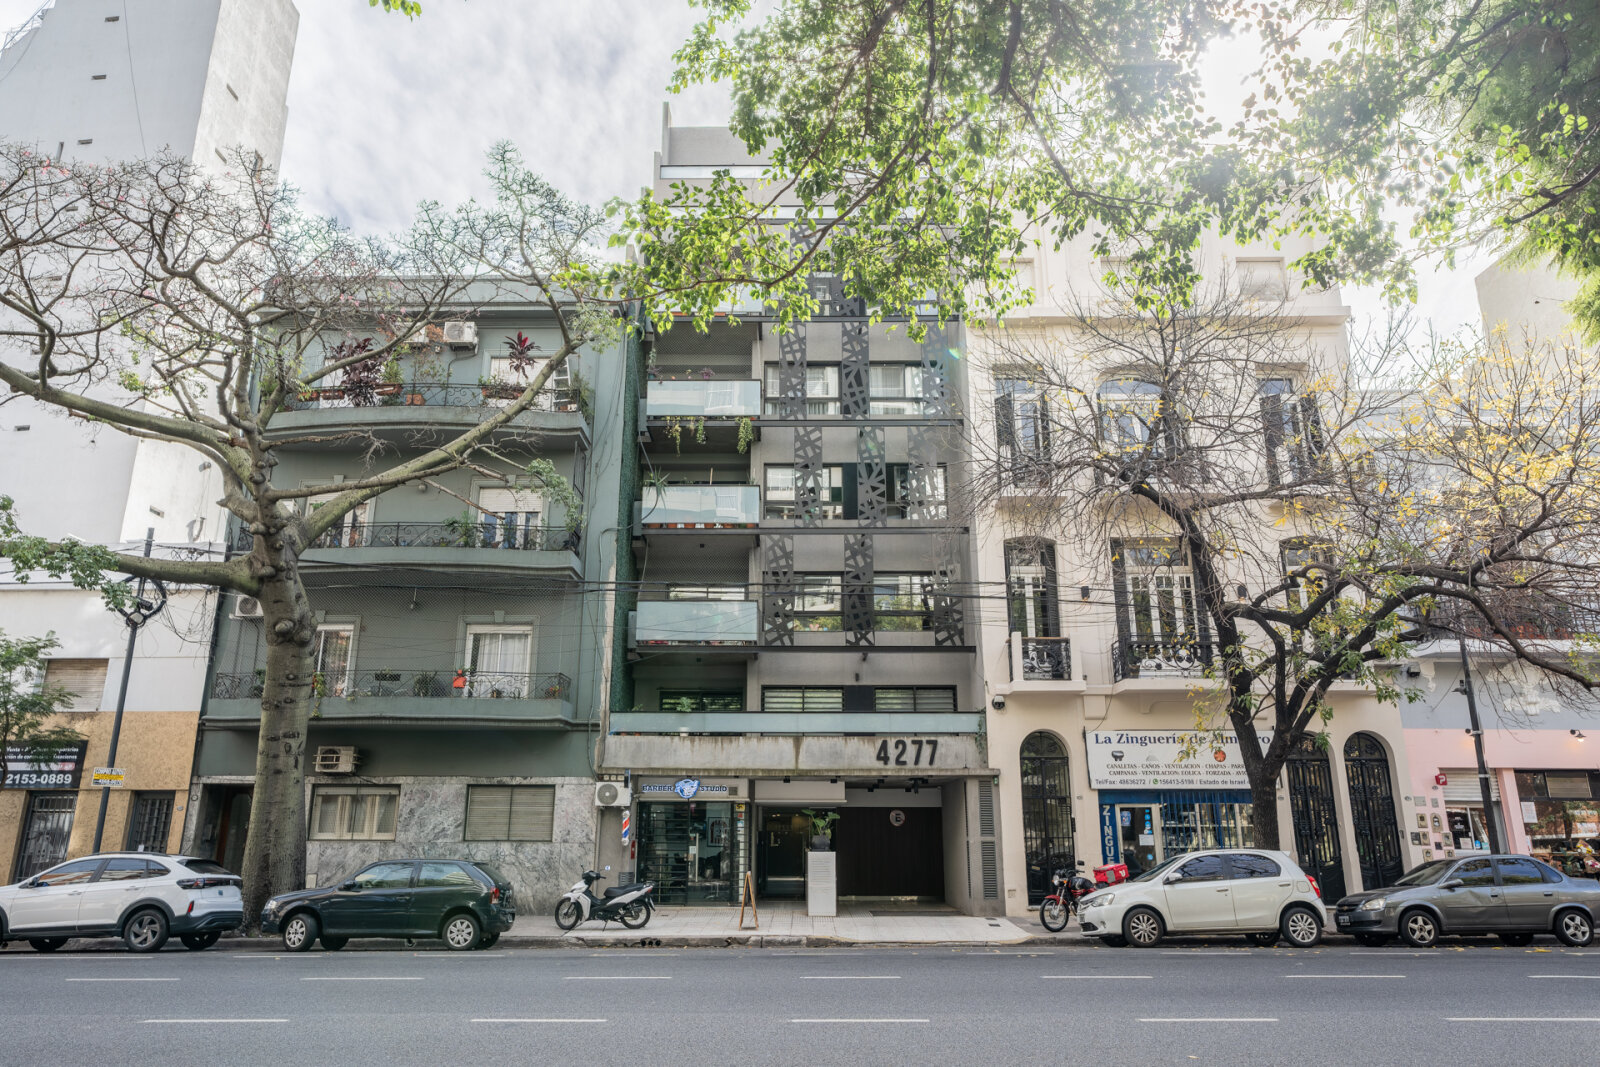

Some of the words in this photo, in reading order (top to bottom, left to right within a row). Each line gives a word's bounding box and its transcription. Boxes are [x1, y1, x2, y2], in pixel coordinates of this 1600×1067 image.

[1095, 733, 1112, 744] La
[1116, 733, 1184, 747] Zinguería
[1190, 733, 1206, 744] de
[1211, 733, 1271, 744] Almo
[876, 739, 938, 766] 4277
[5, 773, 72, 784] 2153-0889
[642, 785, 673, 793] BARBER
[700, 785, 728, 793] STUDIO
